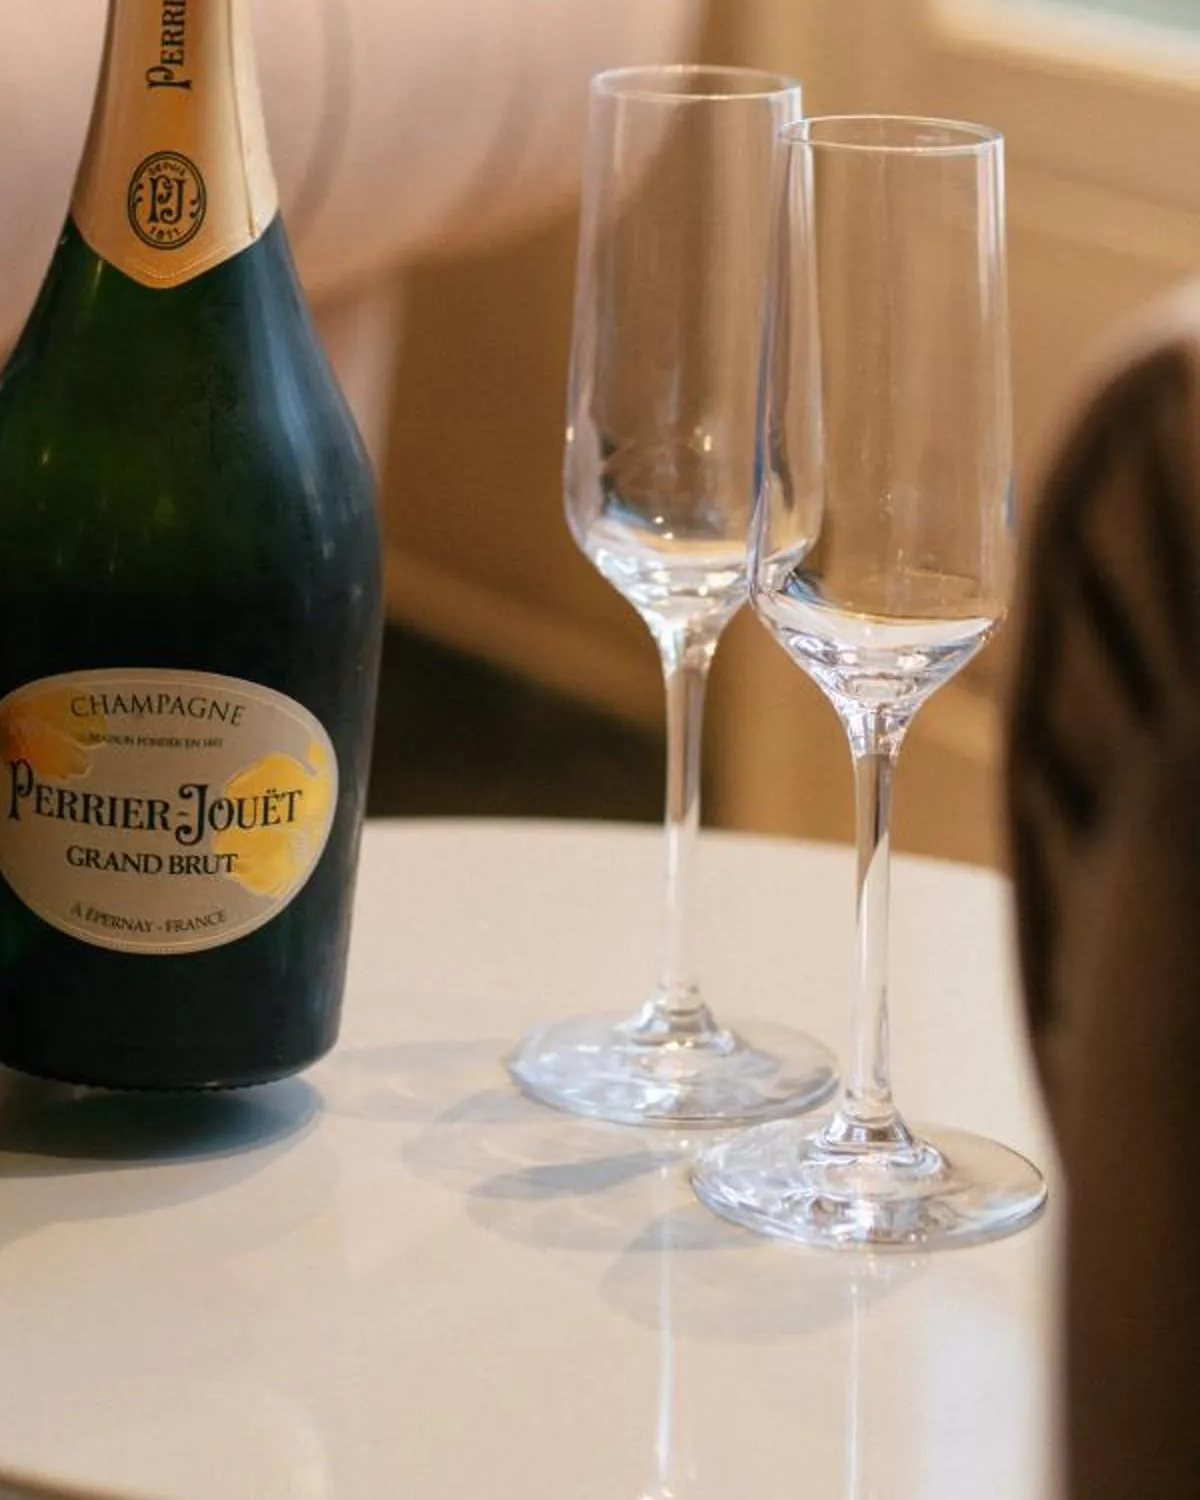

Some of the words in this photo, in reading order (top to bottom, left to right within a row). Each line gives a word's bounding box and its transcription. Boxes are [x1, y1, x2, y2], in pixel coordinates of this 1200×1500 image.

[70, 693, 247, 728] CHAMPAGNE
[7, 758, 303, 846] PERRIER-JOUËT
[66, 845, 162, 875] GRAND
[169, 852, 239, 875] BRUT
[165, 908, 227, 932] FRANCE
